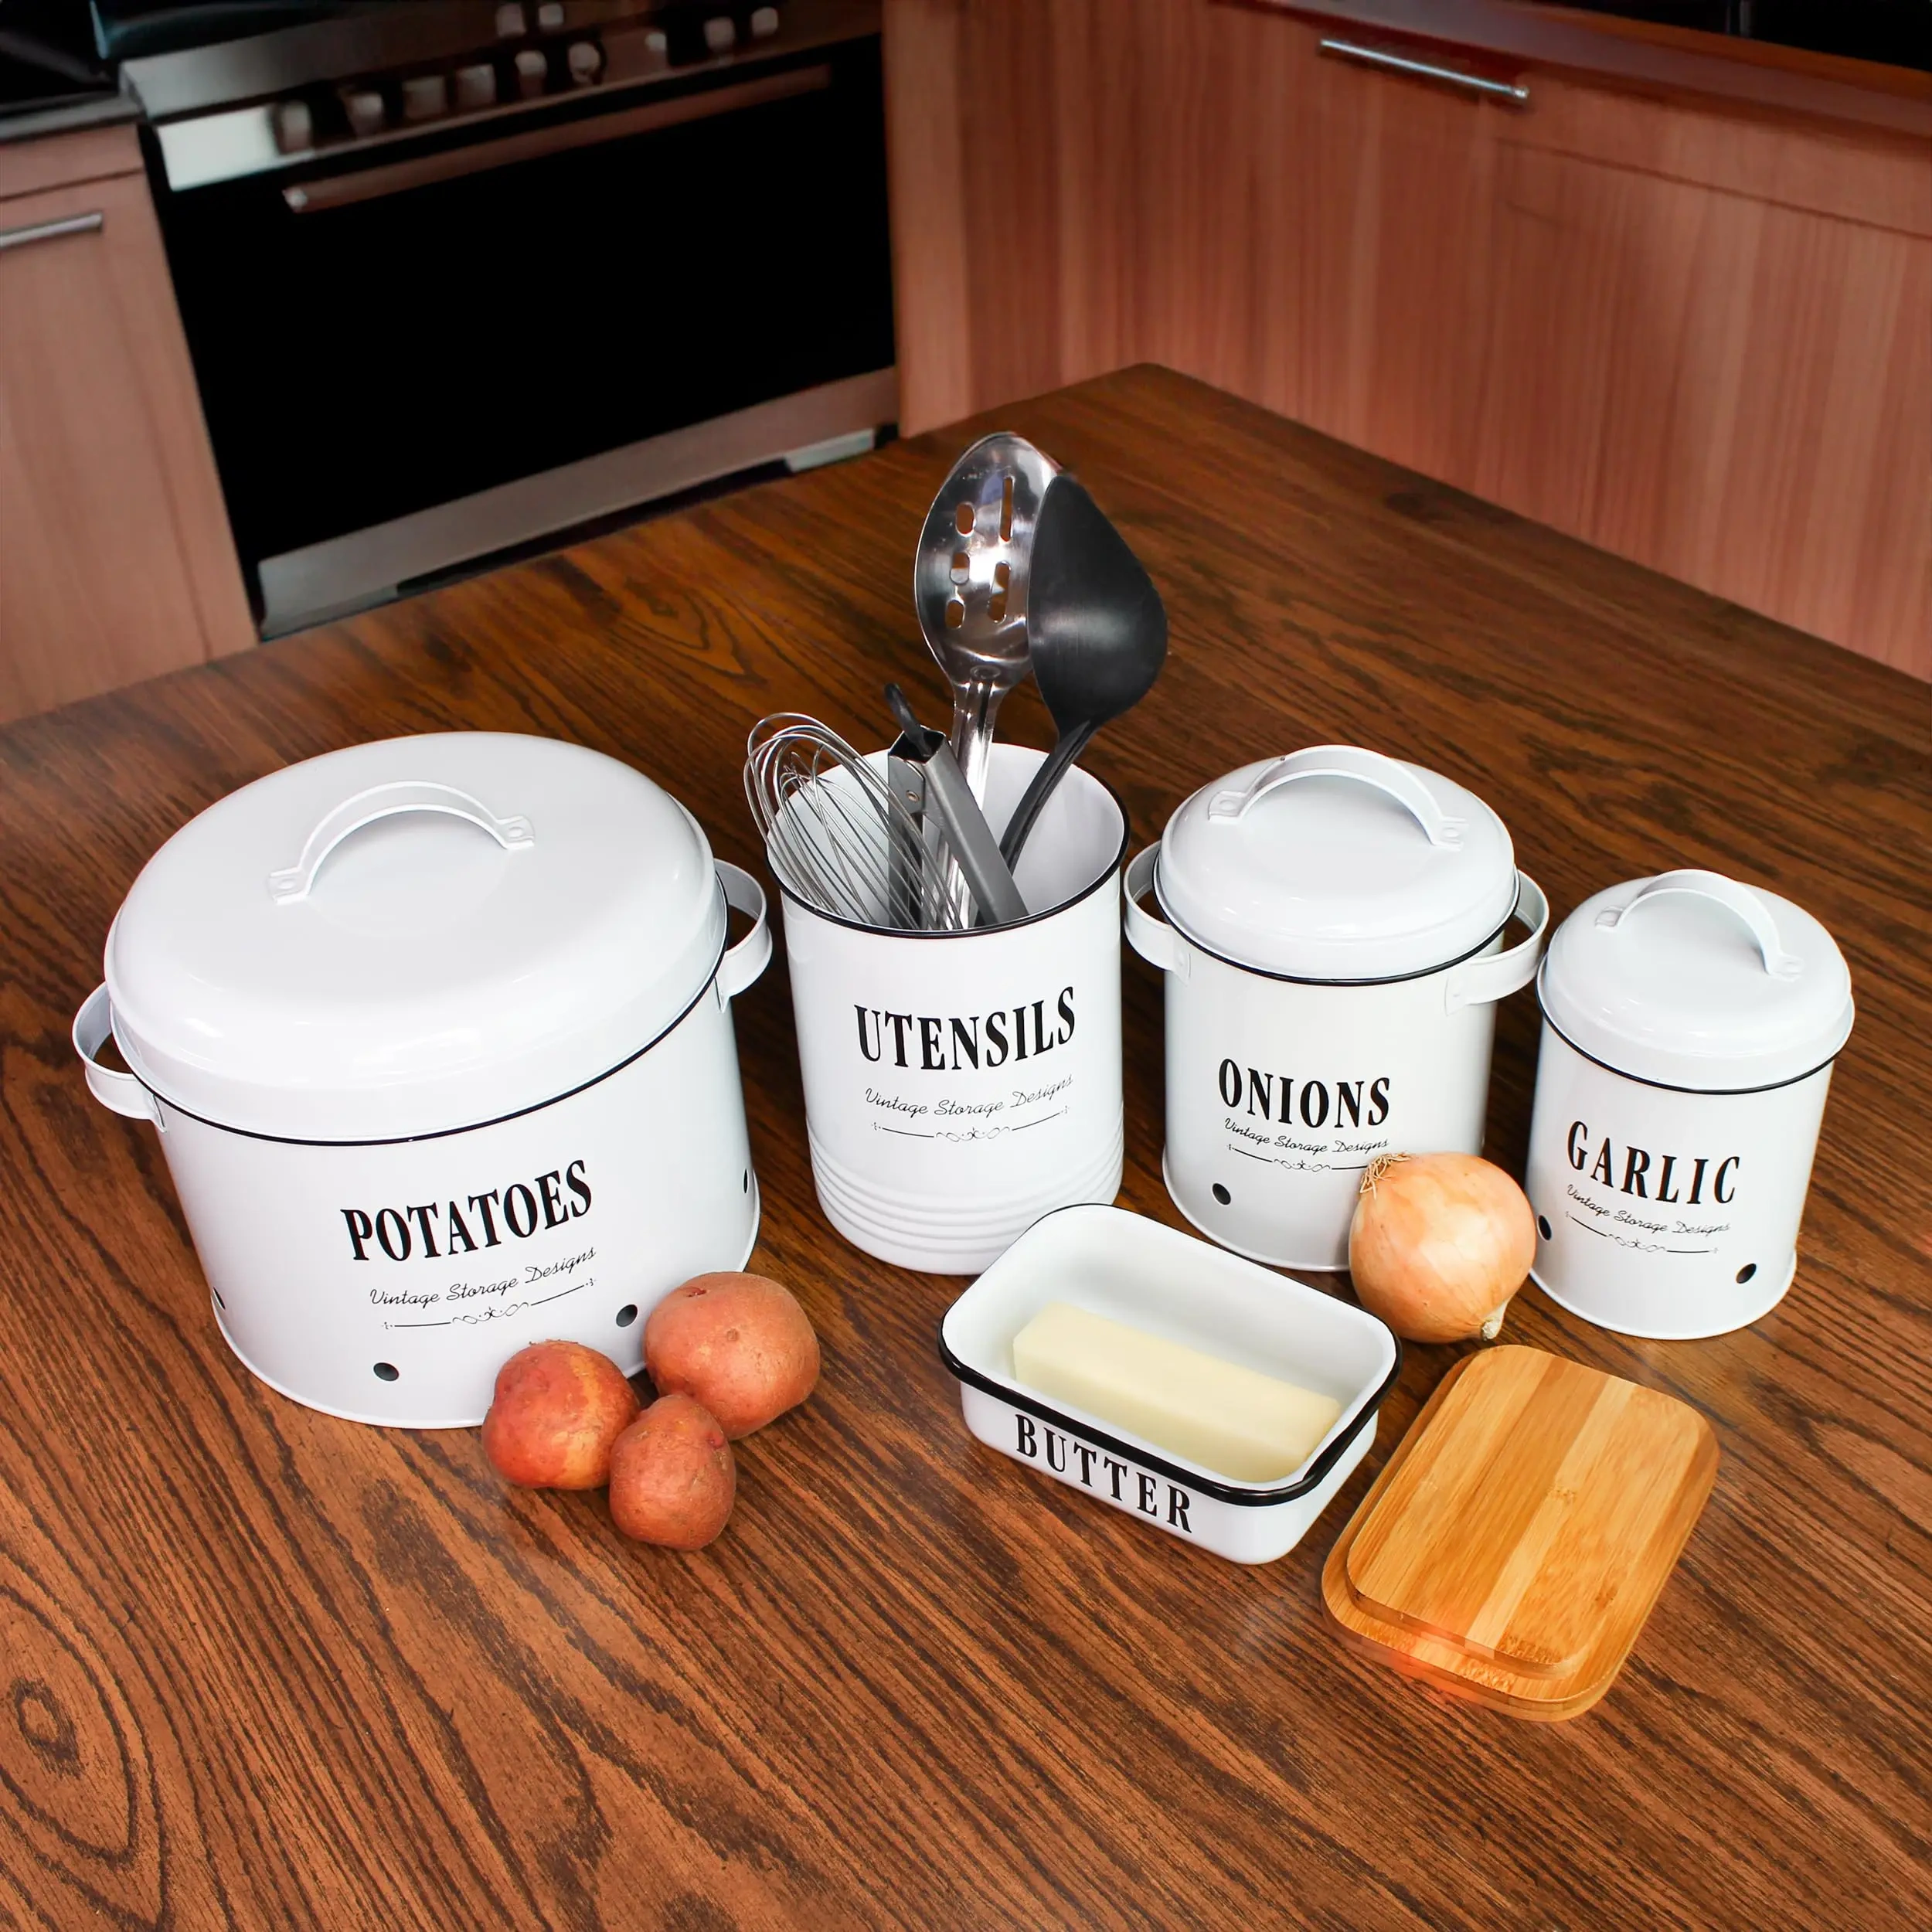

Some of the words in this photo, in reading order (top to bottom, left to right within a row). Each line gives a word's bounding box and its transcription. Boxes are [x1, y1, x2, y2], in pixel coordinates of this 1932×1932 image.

[854, 986, 1075, 1070] UTENSILS
[865, 1087, 928, 1118] Vintage
[934, 1100, 1005, 1118] Storage
[1010, 1074, 1073, 1108] Designs
[1219, 1058, 1389, 1128] ONIONS
[1225, 1117, 1270, 1145] Vintage
[1274, 1135, 1328, 1155] Storage
[1332, 1138, 1389, 1155] Designs
[1567, 1121, 1740, 1204] GARLIC
[340, 1159, 592, 1261] POTATOES
[1567, 1184, 1611, 1216] Vintage
[1614, 1210, 1668, 1233] Storage
[1672, 1221, 1730, 1236] Designs
[369, 1288, 440, 1309] Vintage
[446, 1275, 519, 1301] Storage
[525, 1247, 597, 1284] Designs
[1015, 1413, 1192, 1533] BUTTER
